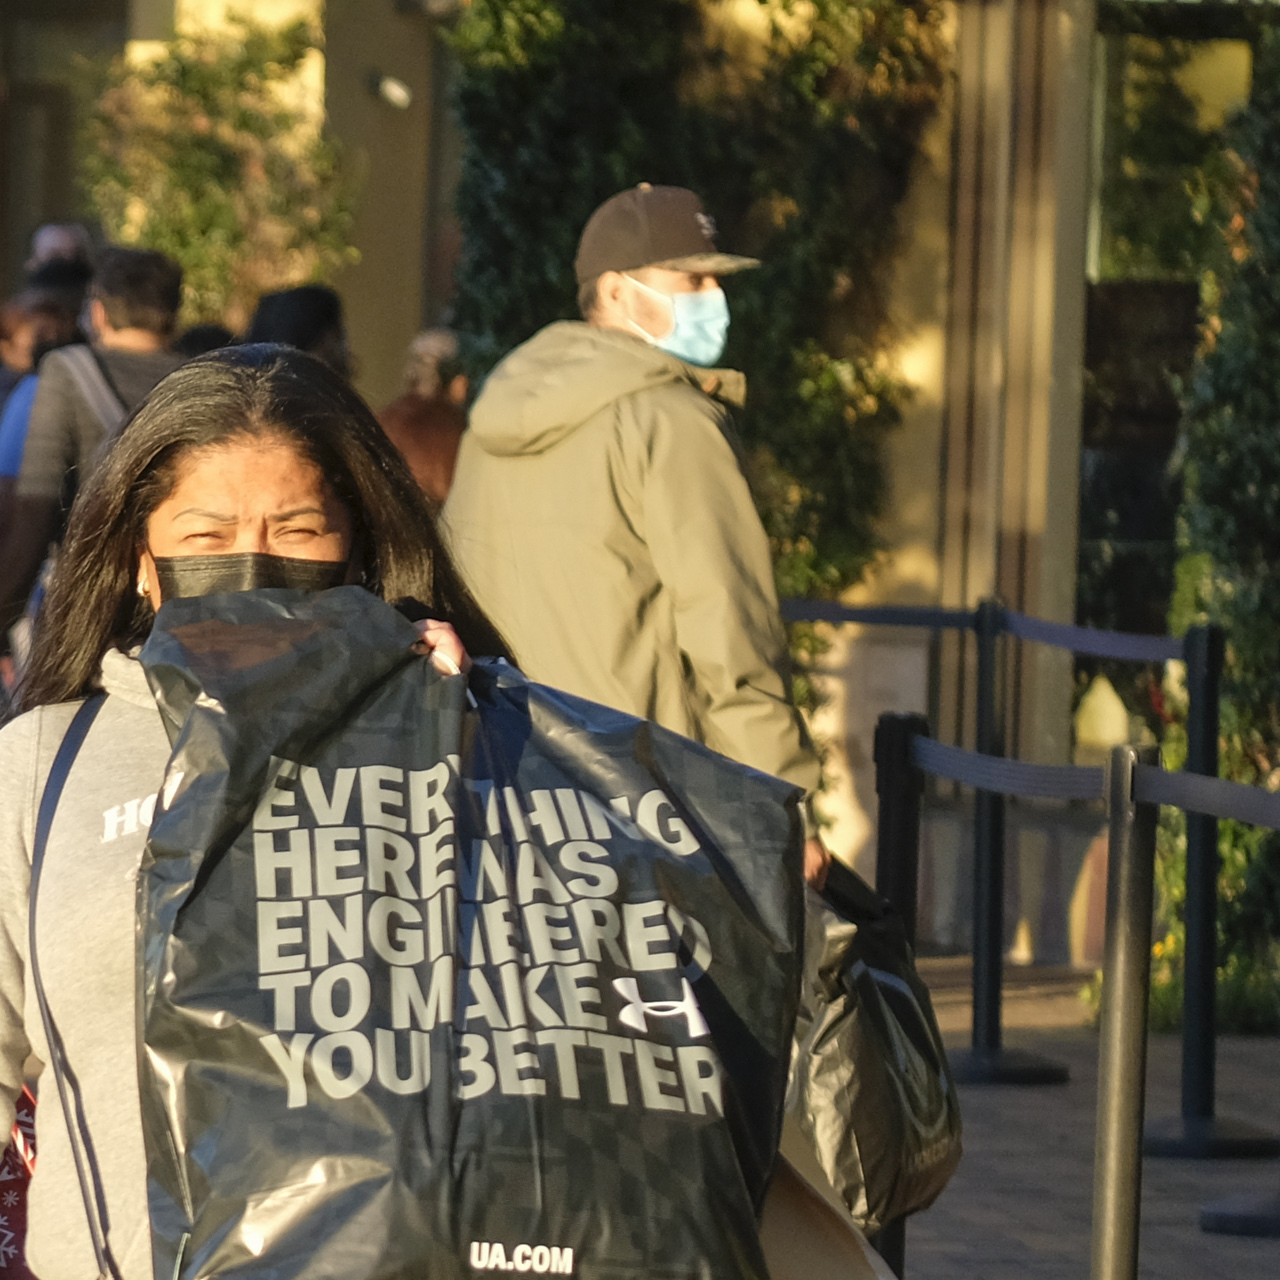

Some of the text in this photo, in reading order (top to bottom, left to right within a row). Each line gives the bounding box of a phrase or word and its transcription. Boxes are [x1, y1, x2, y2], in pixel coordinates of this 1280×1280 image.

[252, 754, 701, 856] EVERTHING
[253, 819, 456, 900] HERE
[258, 955, 608, 1033] TO MAKE
[259, 1027, 725, 1118] YOU BETTER
[469, 1240, 574, 1275] UA.COM
